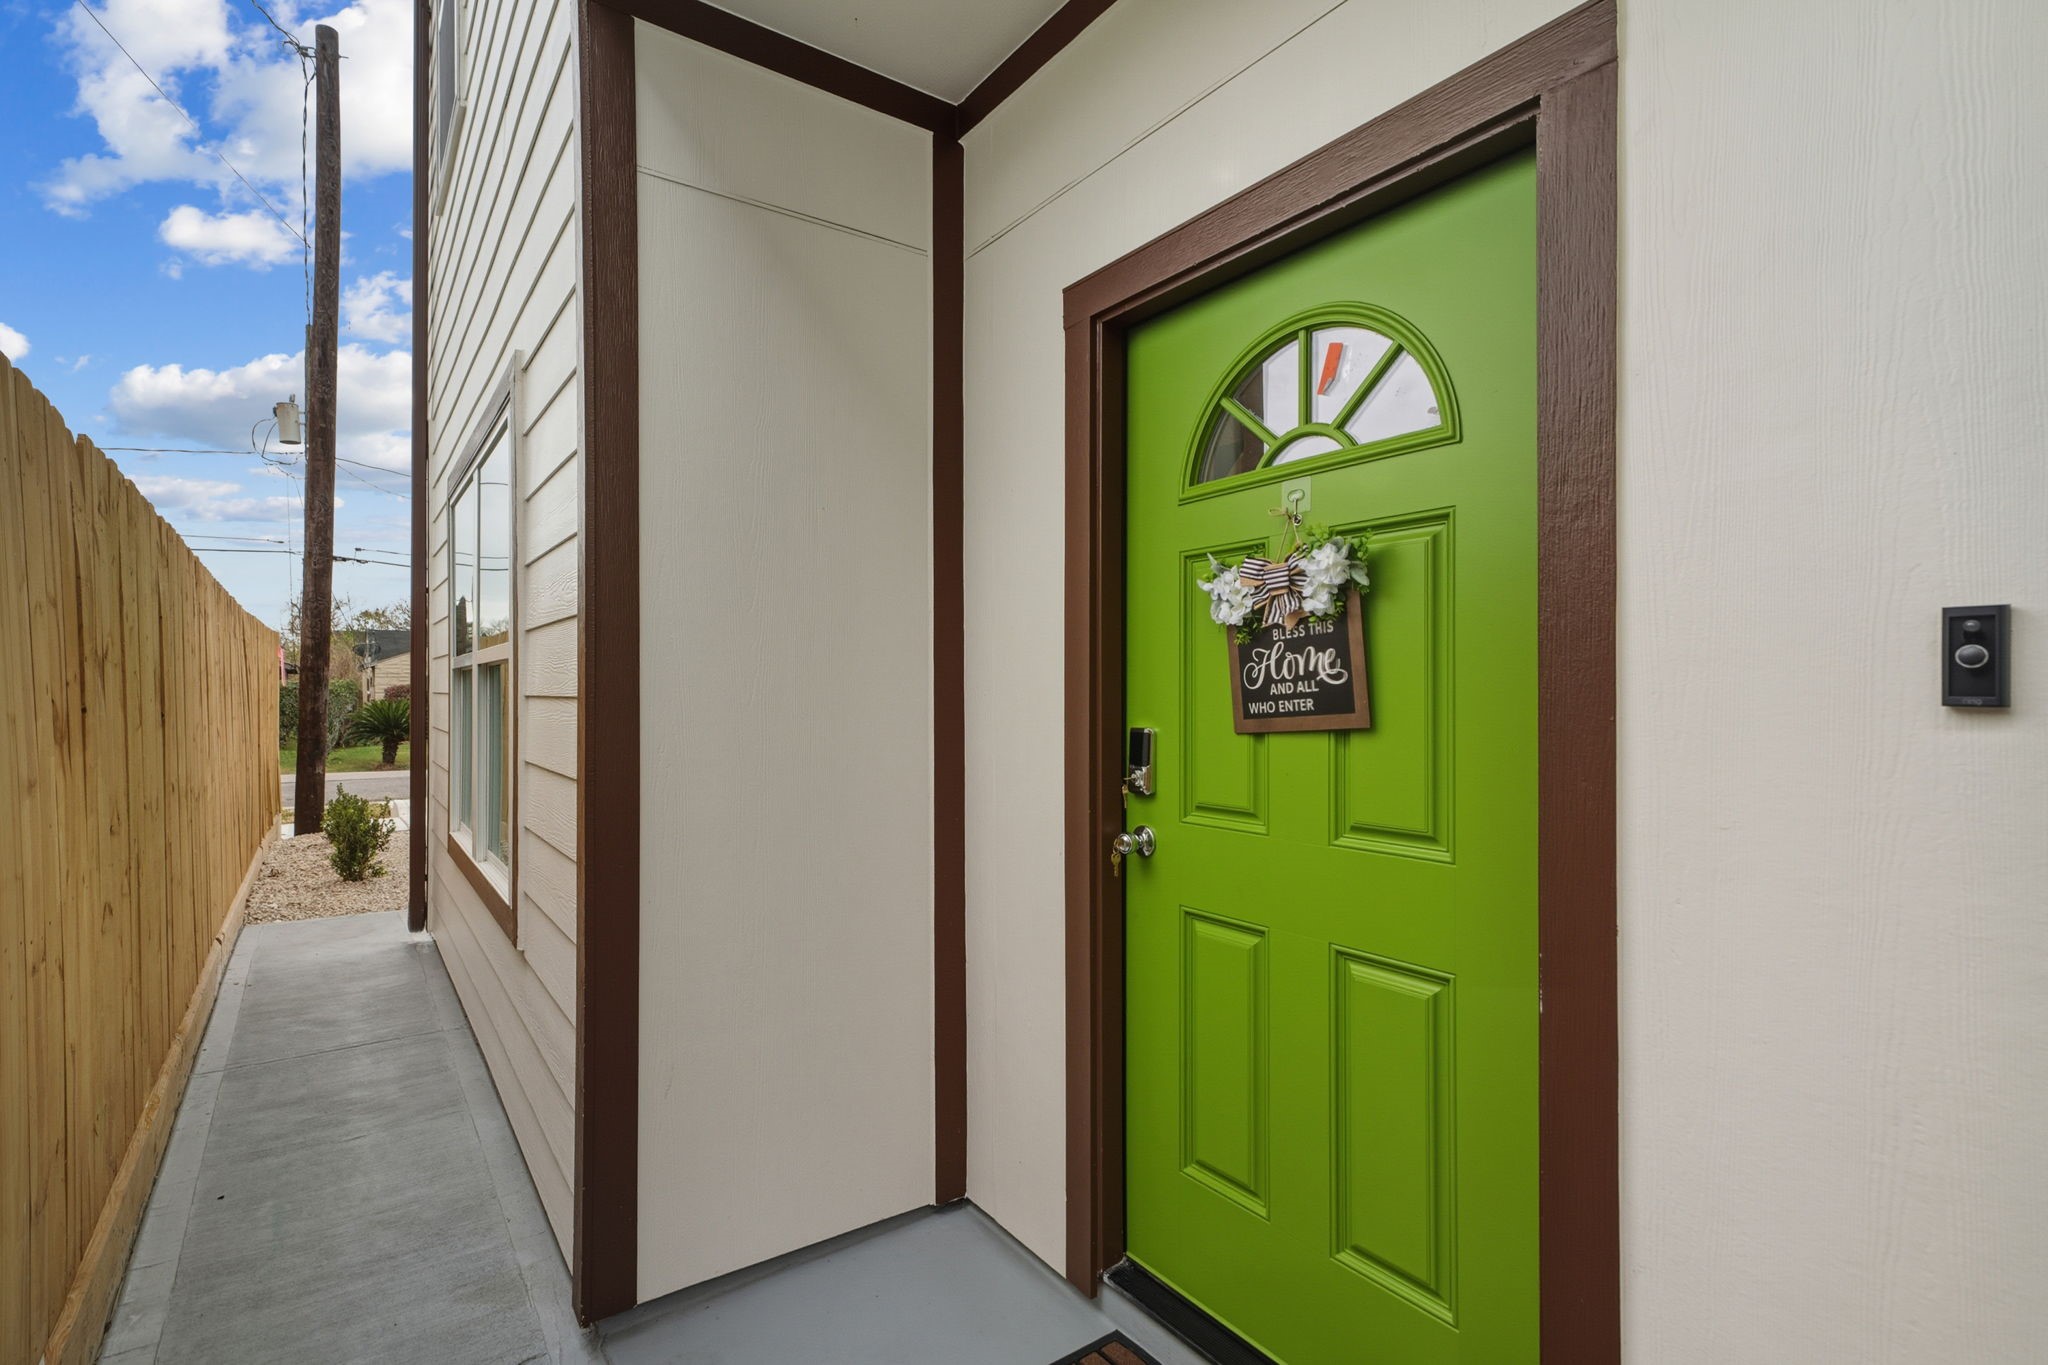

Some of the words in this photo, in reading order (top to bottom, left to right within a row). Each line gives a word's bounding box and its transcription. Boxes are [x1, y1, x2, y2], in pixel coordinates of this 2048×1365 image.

[1272, 624, 1306, 640] BLESS
[1308, 620, 1334, 635] THIS
[1243, 641, 1348, 689] Home
[1270, 682, 1294, 695] AND
[1297, 680, 1319, 693] ALL
[1248, 702, 1275, 714] WHO
[1279, 698, 1315, 712] ENTER
